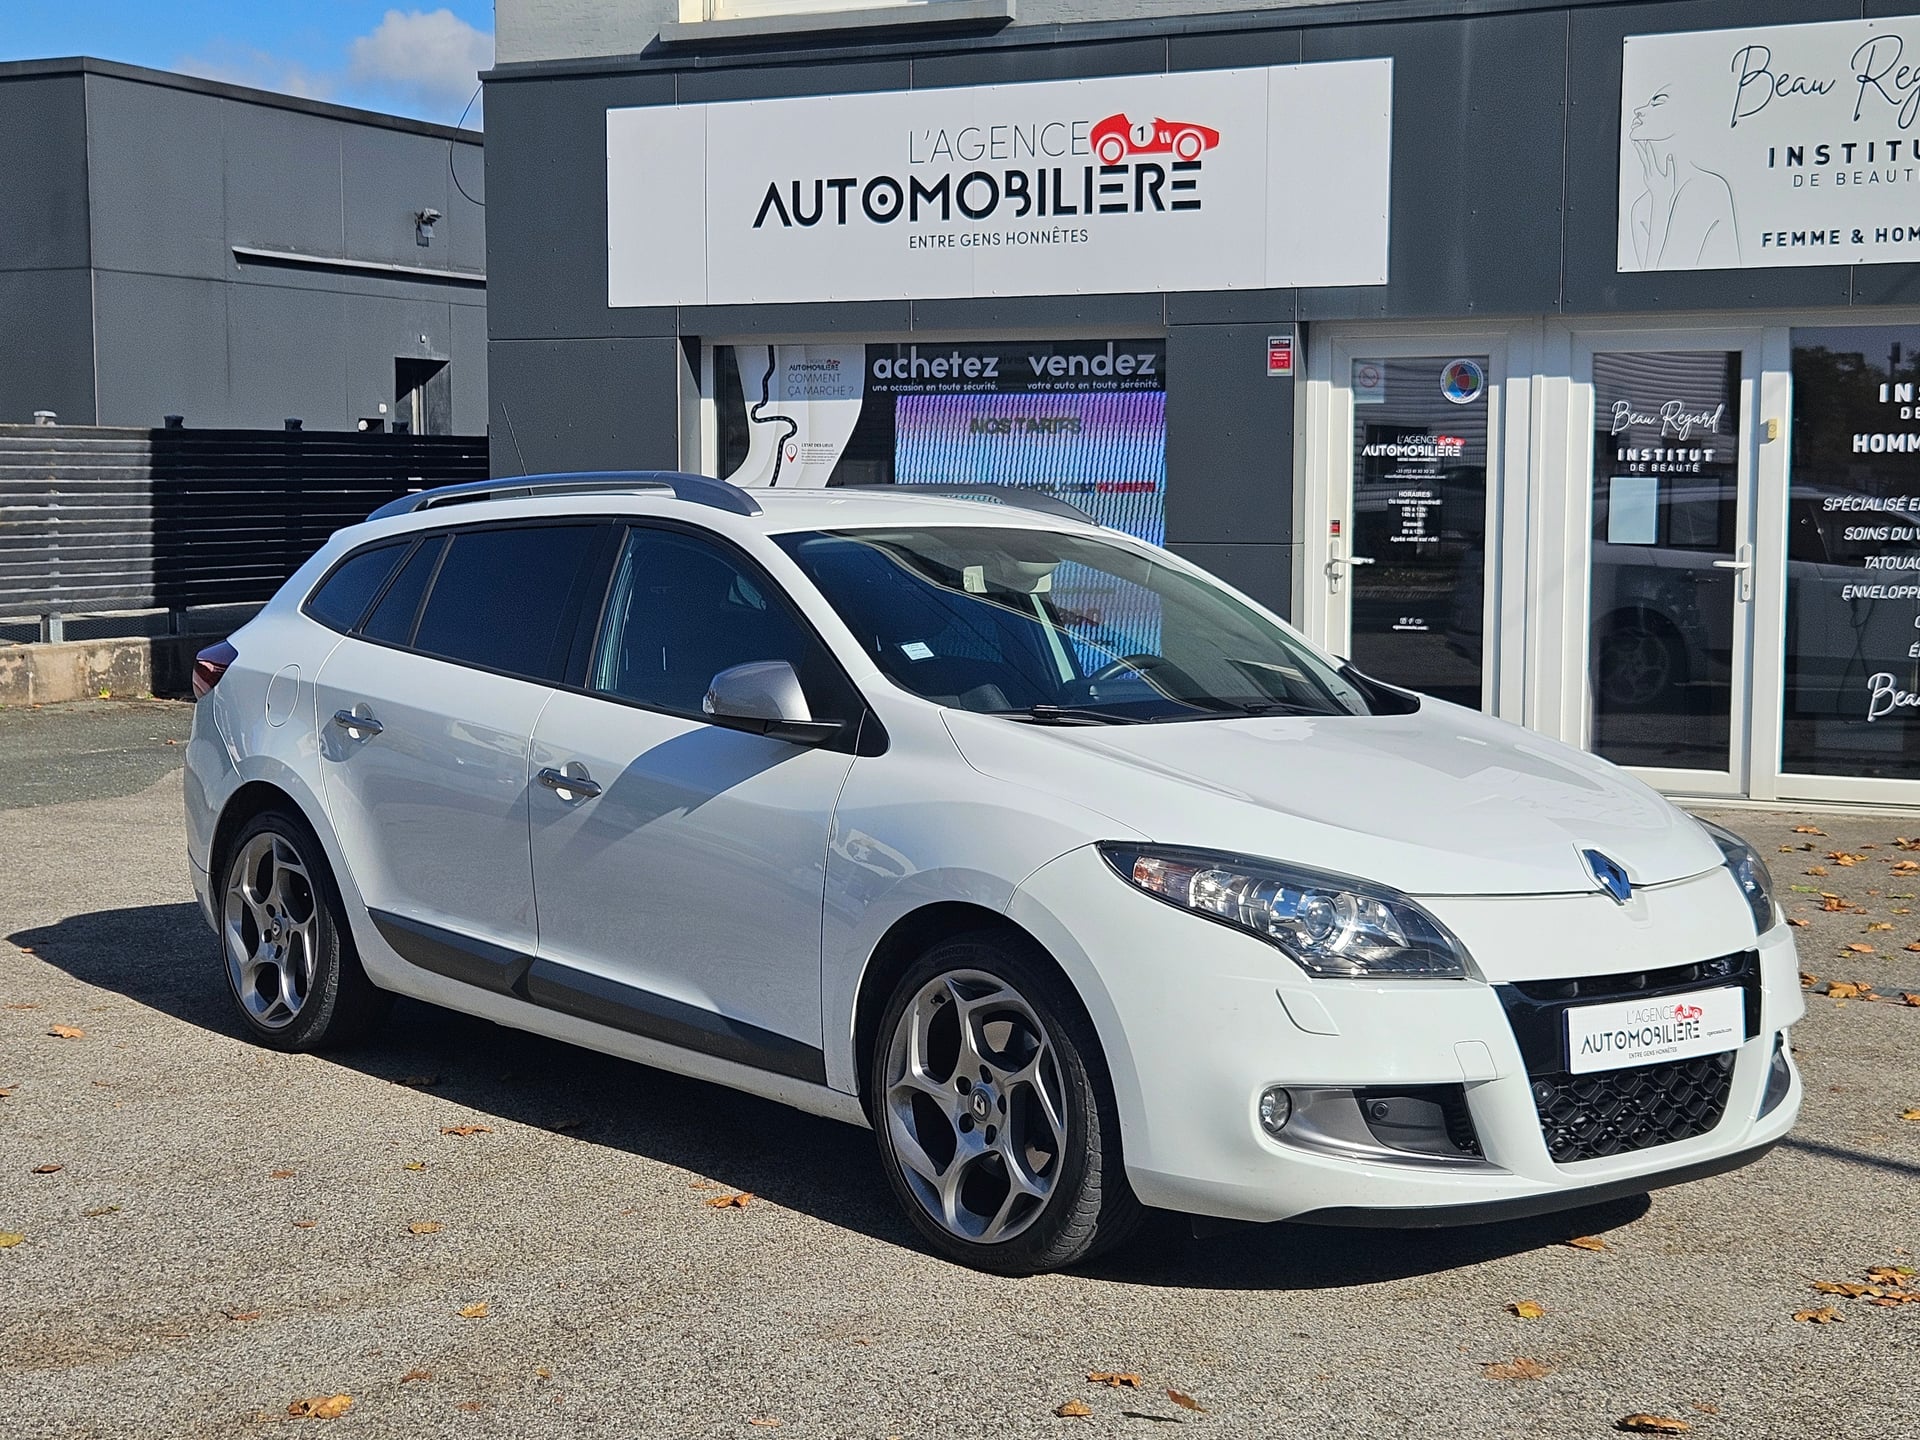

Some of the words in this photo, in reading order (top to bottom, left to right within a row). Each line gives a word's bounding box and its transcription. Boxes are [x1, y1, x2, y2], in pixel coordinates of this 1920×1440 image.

[1731, 45, 1836, 128] Beau
[909, 121, 1089, 164] L'AGENCE
[1793, 174, 1820, 188] DE
[909, 233, 955, 248] ENTRE
[960, 232, 1001, 246] GENS
[1006, 226, 1088, 245] HONNÊTES
[1762, 230, 1840, 247] FEMME
[1851, 229, 1864, 244] &
[873, 346, 999, 379] achetez
[1028, 342, 1156, 376] vendez
[788, 373, 841, 383] COMMENT
[890, 382, 923, 391] occasion
[939, 383, 960, 391] toute
[964, 381, 998, 391] sécurité.
[1027, 382, 1051, 390] votre
[1054, 382, 1075, 390] auto
[1093, 381, 1117, 389] toute
[1121, 379, 1160, 389] sérénité.
[788, 386, 801, 397] ÇA
[848, 386, 854, 395] ?
[1879, 383, 1920, 403] IN
[969, 417, 1010, 434] NOS
[1611, 400, 1656, 436] Beau
[1660, 400, 1725, 441] Regard
[1397, 435, 1437, 444] L'AGENCE
[1617, 448, 1716, 462] INSTITUT
[1630, 464, 1645, 472] DE
[1823, 494, 1908, 511] SPÉCIALISÉ
[1908, 497, 1920, 511] E
[1843, 527, 1888, 540] SOINS
[1890, 527, 1913, 540] DU
[1842, 584, 1920, 600] ENVELOPP
[1867, 672, 1920, 722] Bea
[1626, 1005, 1675, 1025] L'AGENCE
